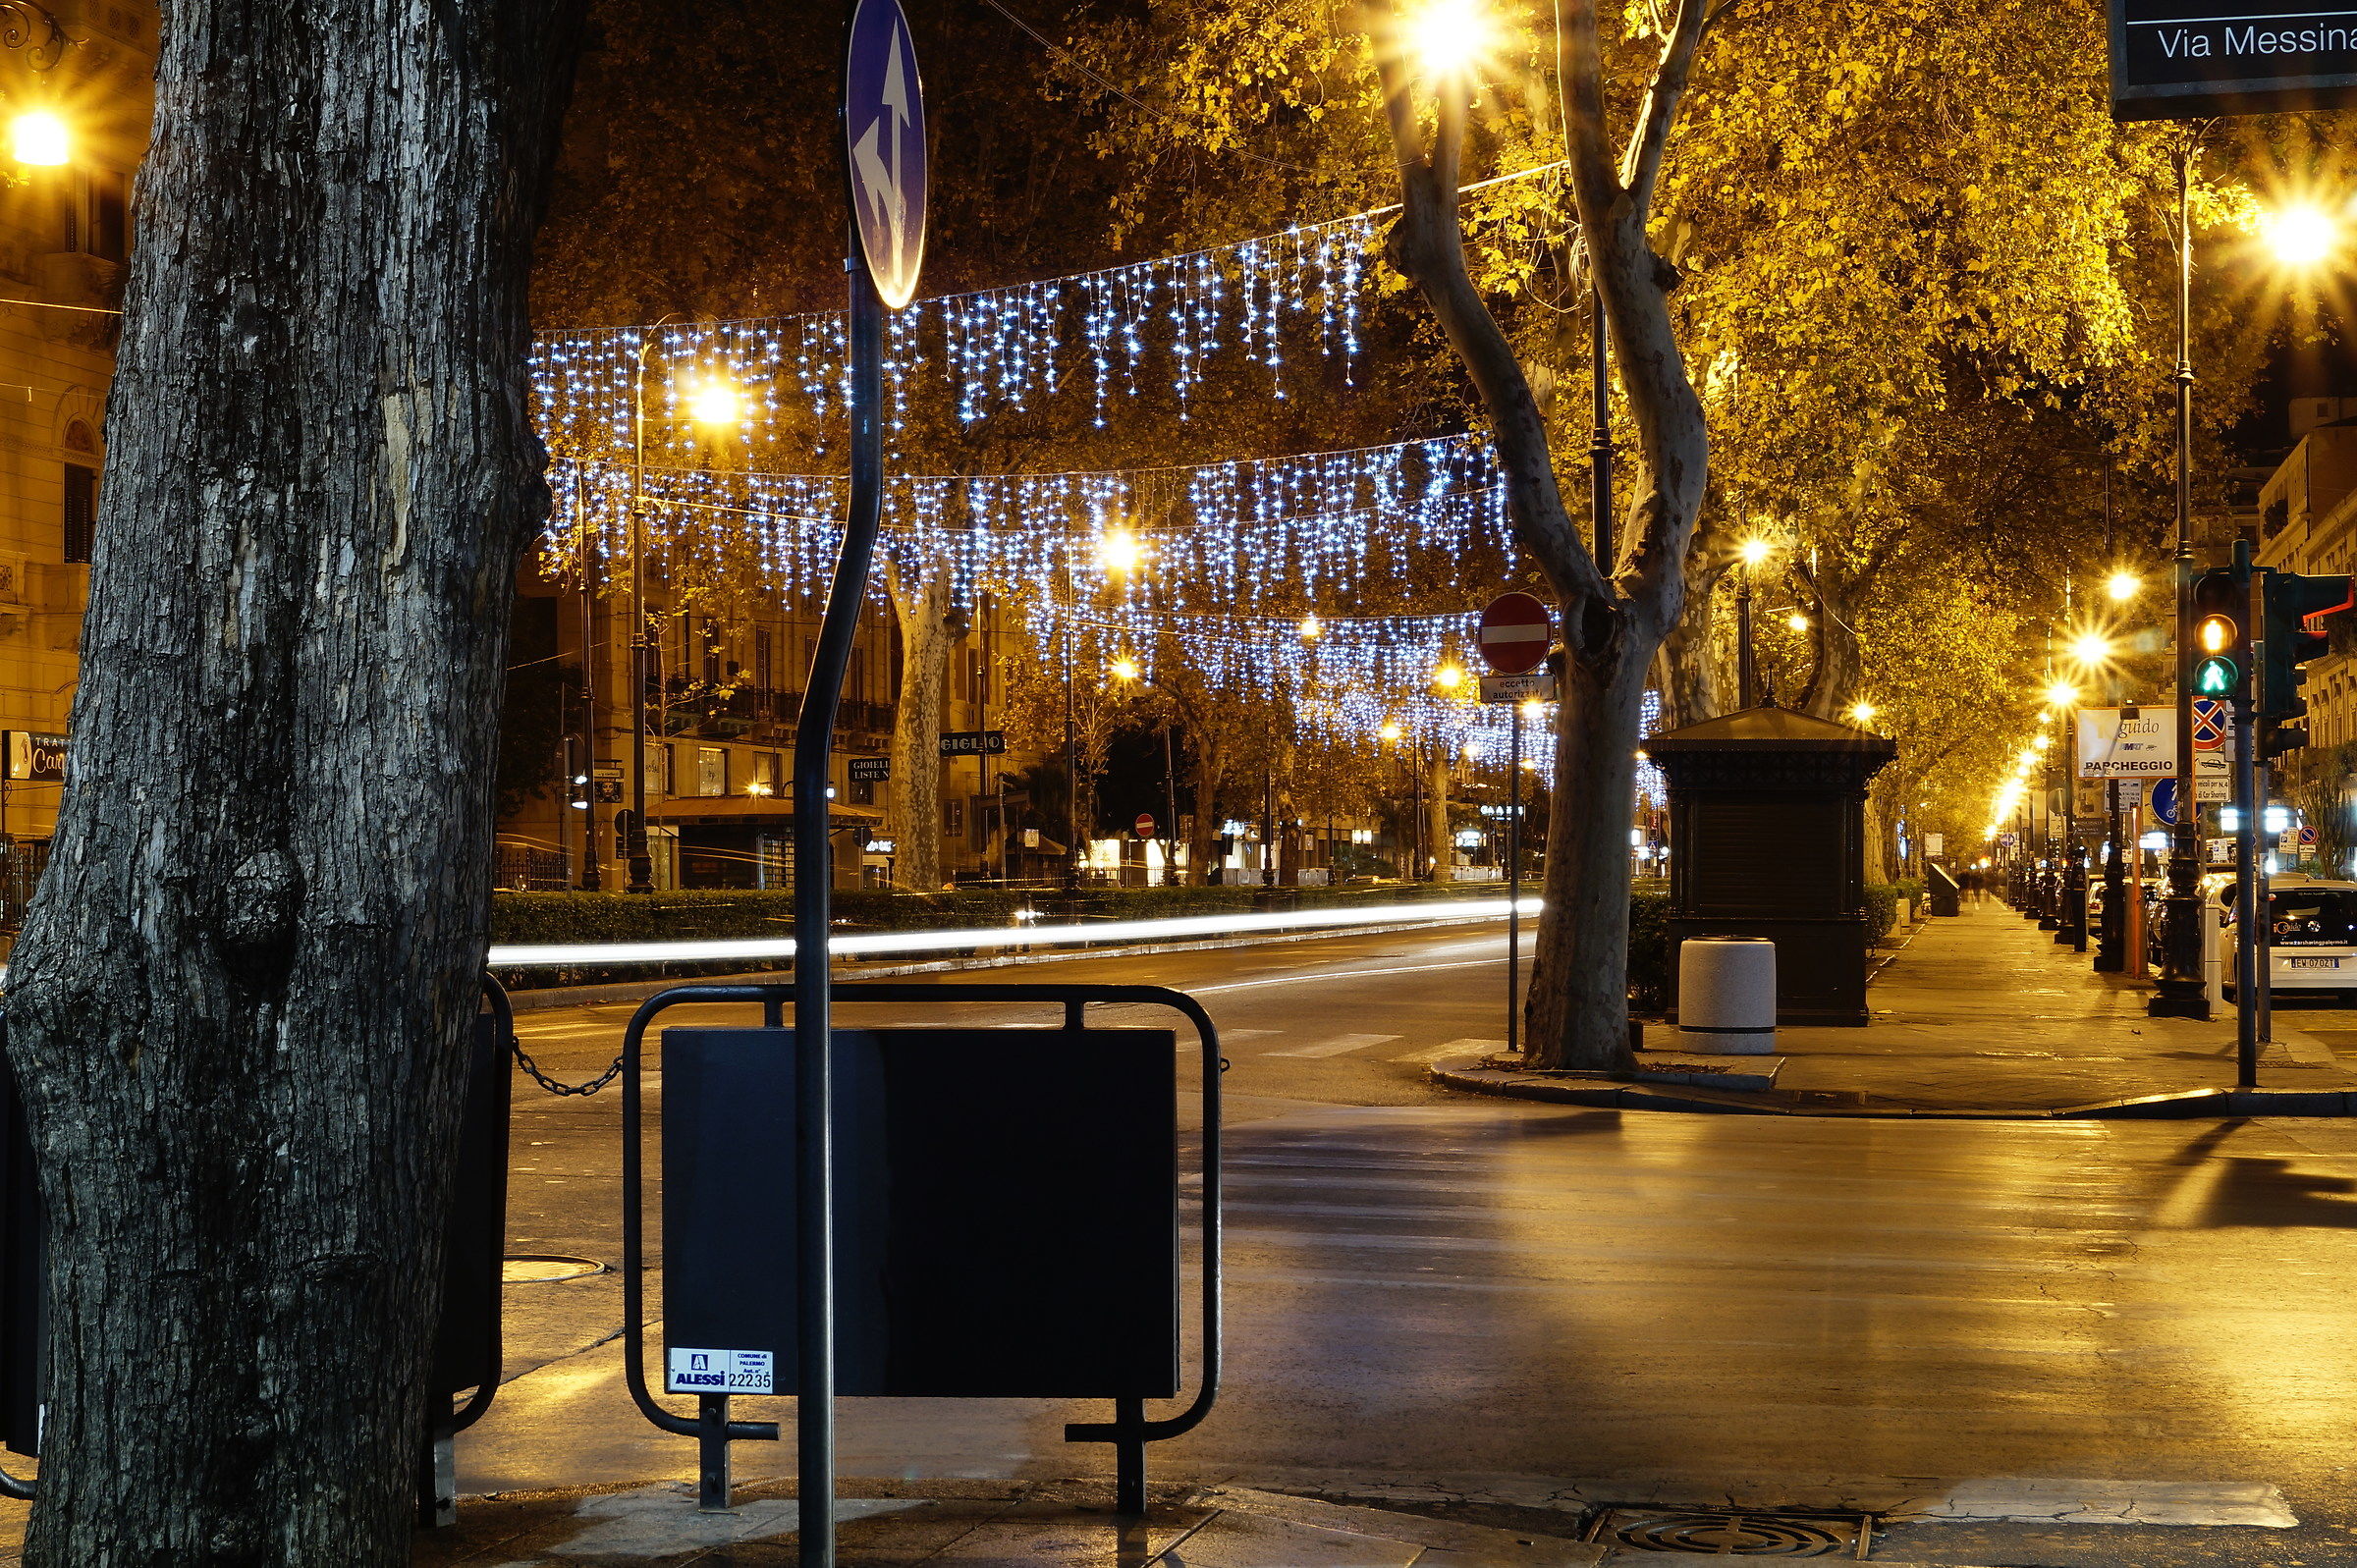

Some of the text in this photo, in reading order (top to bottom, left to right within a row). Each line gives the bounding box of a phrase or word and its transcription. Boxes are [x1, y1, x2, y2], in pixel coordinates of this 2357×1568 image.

[2158, 28, 2211, 58] Via
[1499, 678, 1535, 688] eccetto
[2117, 718, 2160, 738] guido
[729, 1373, 771, 1387] 22235
